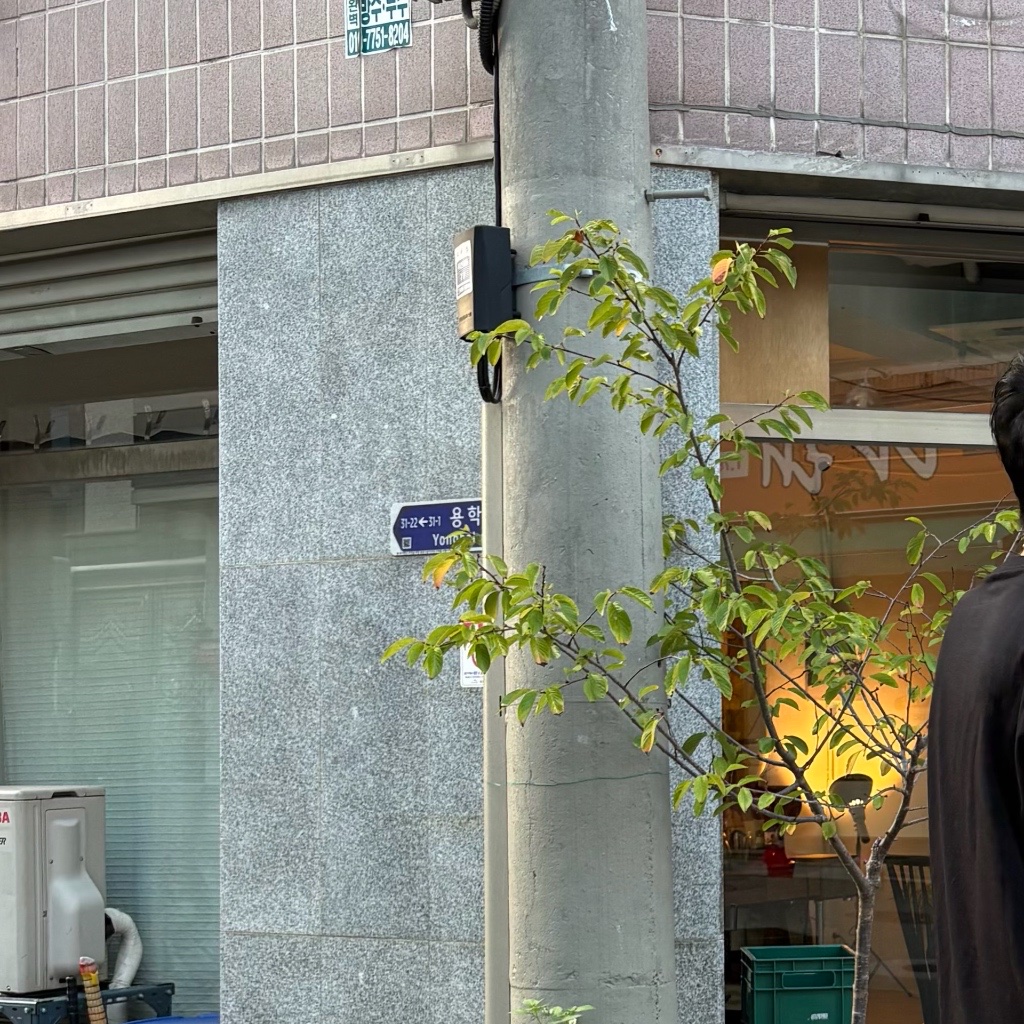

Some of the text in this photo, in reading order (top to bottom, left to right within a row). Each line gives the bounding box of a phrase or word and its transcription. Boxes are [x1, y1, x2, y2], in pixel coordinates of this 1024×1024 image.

[348, 21, 409, 54] 01-7751-8204
[400, 516, 442, 529] 31-22 31-1
